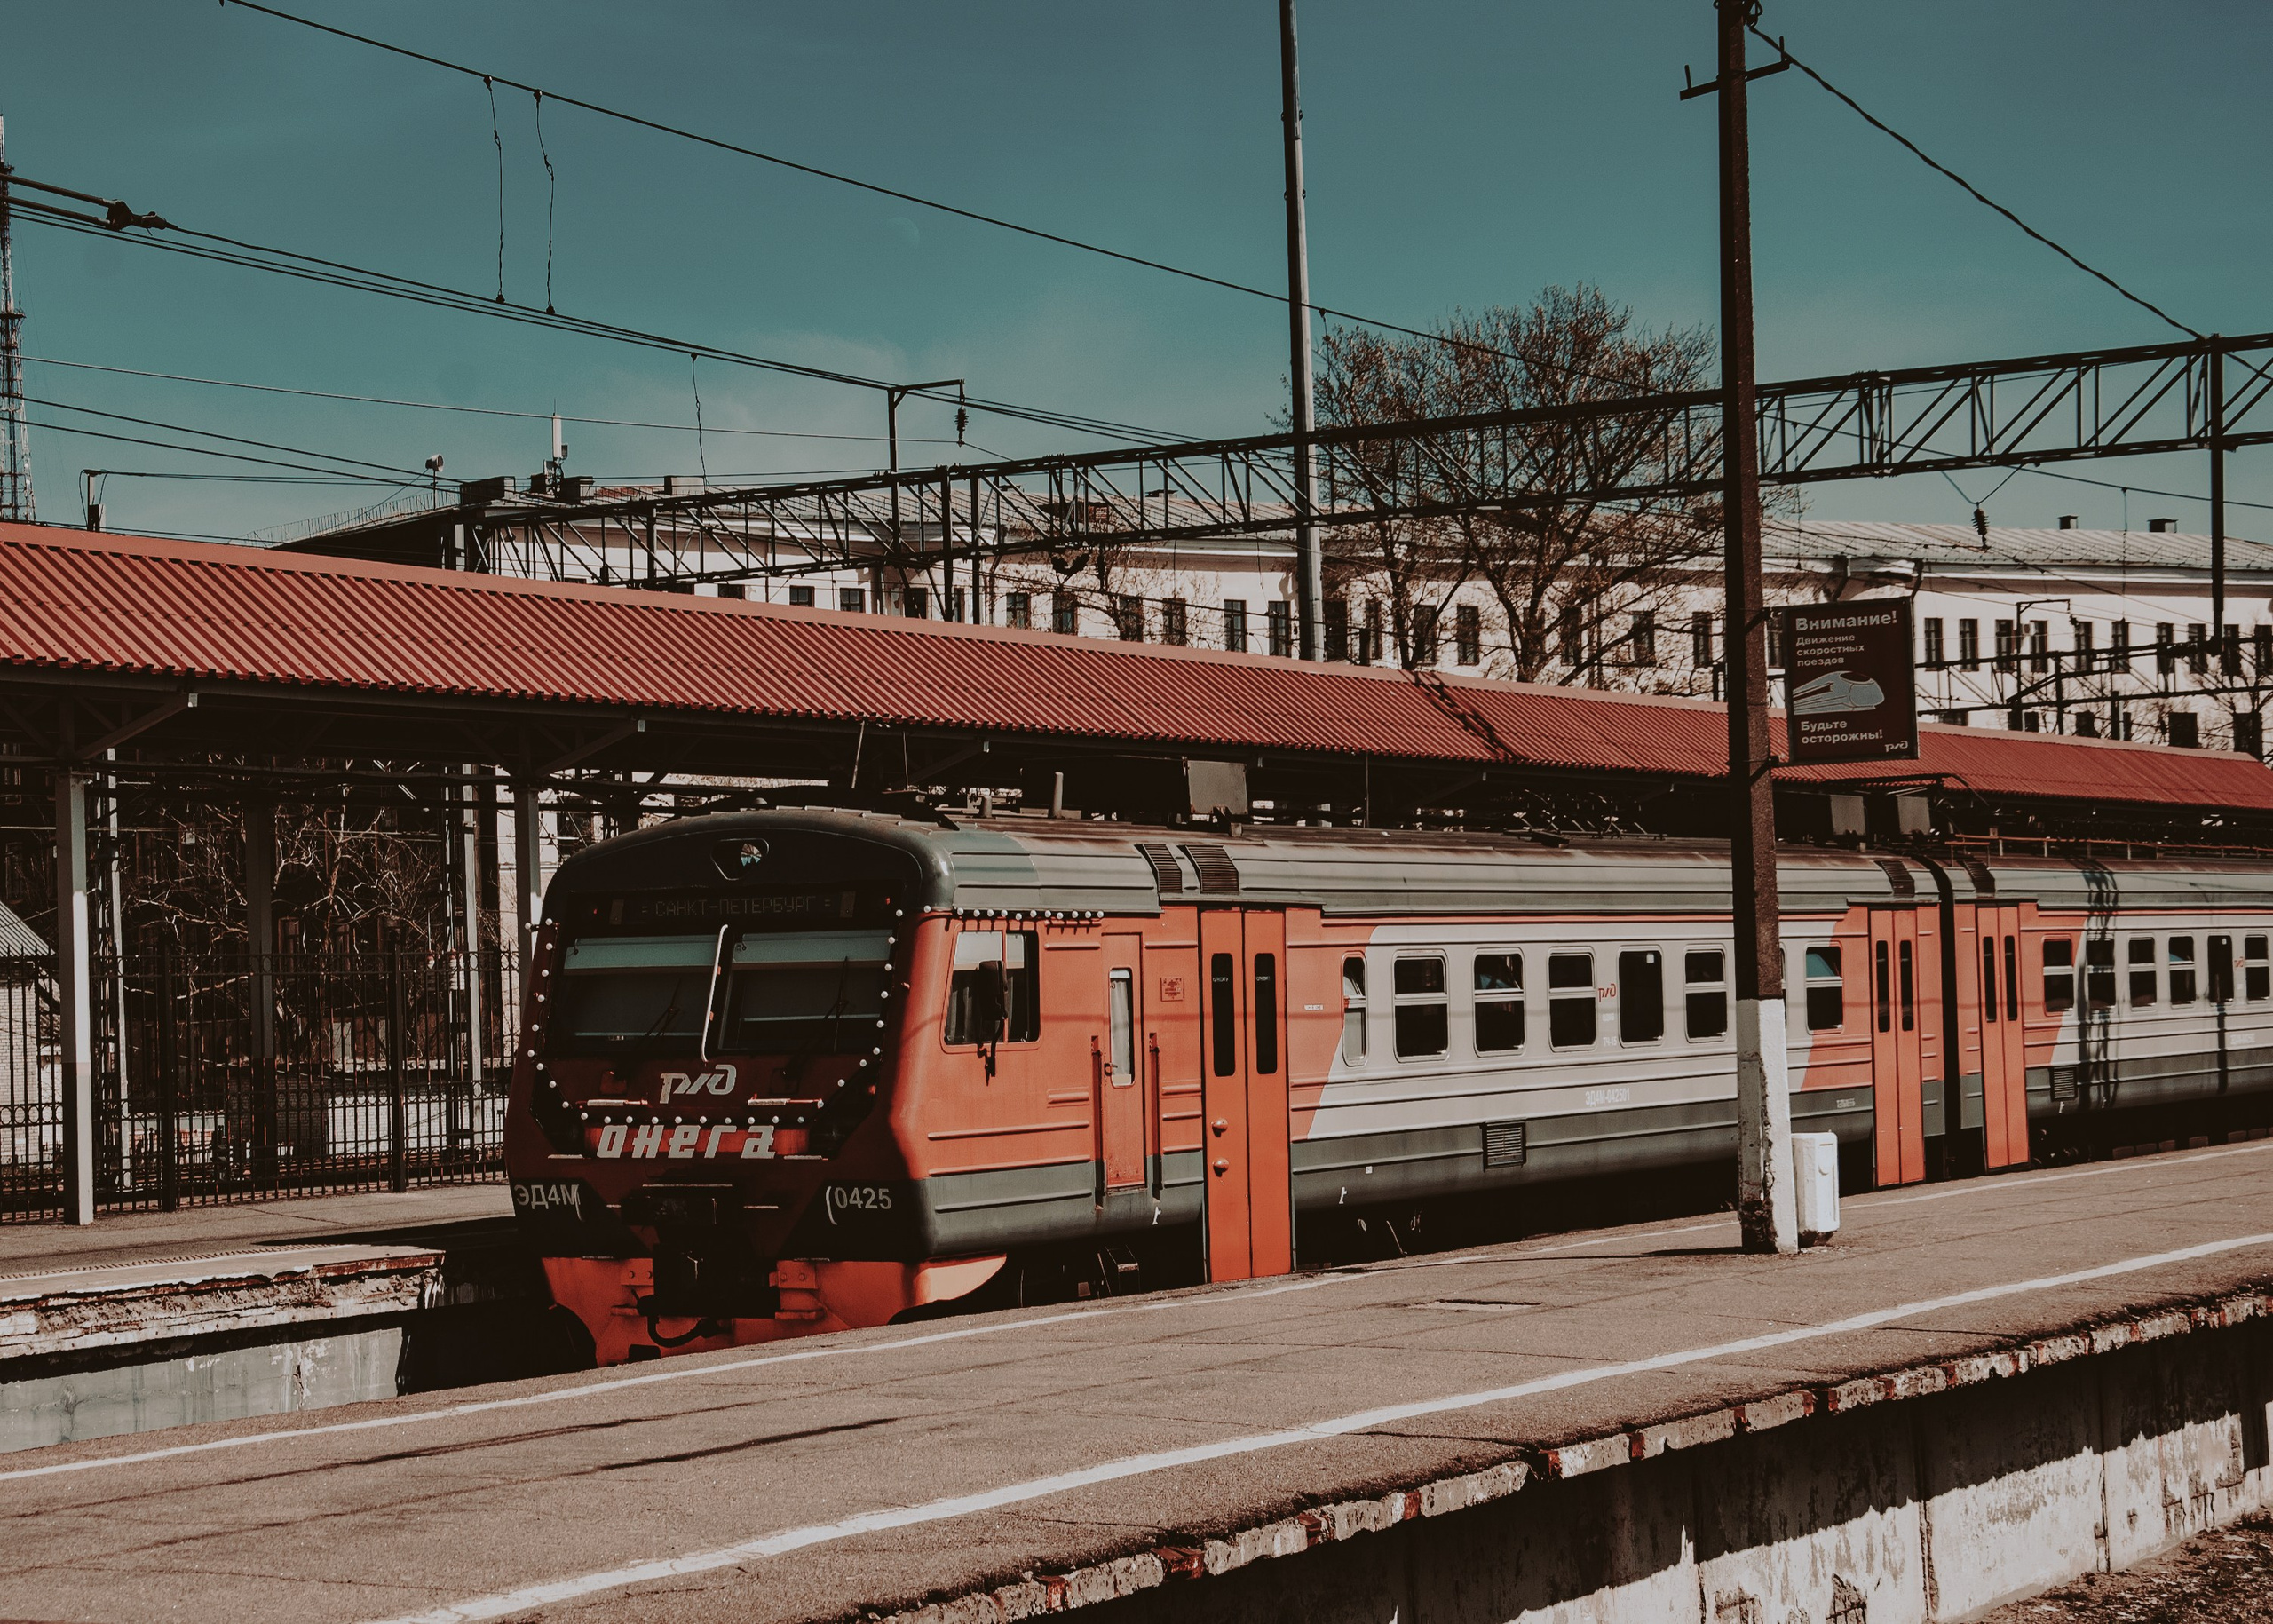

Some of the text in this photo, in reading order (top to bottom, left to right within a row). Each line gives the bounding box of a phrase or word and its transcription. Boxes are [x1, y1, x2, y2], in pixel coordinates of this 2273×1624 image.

[1795, 611, 1897, 631] Внимание!
[1795, 634, 1856, 646] Движение
[1796, 645, 1865, 657] скоростных
[1797, 657, 1845, 668] поездов
[1801, 720, 1847, 733] Будьте
[1802, 729, 1883, 746] осторожны!
[655, 896, 816, 916] САНКТ-ПЕТЕРБУРГ
[514, 1184, 581, 1210] ЭД4М
[835, 1187, 892, 1210] 0425
